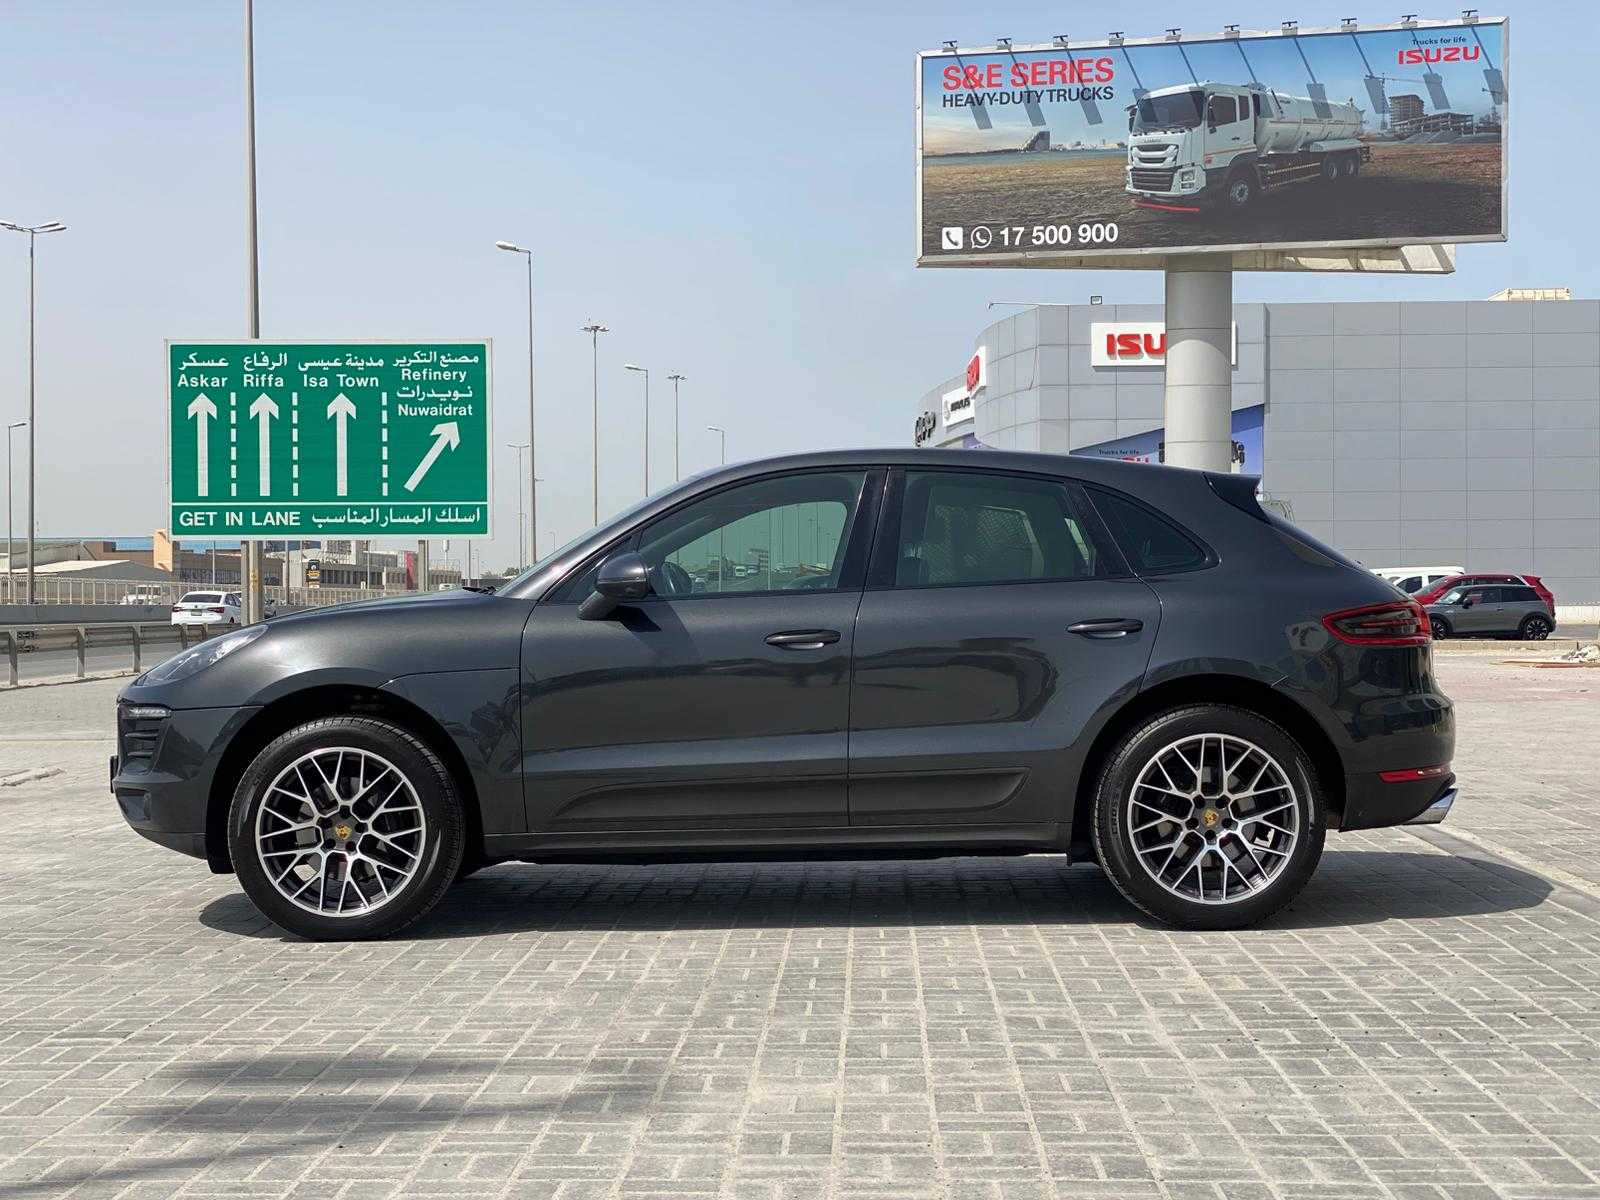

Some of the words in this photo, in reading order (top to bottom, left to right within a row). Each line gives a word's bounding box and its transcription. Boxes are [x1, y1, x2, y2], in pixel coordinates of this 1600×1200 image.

[1398, 46, 1479, 65] ISUZU
[943, 63, 1003, 90] S&E
[1010, 57, 1114, 88] SERIES
[942, 88, 1046, 108] HEAVY-DUTY
[1046, 85, 1114, 103] TRUCKS
[1000, 226, 1025, 246] 17
[1031, 225, 1072, 245] 500
[1078, 222, 1119, 243] 900
[1106, 333, 1167, 356] ISU
[178, 352, 229, 370] عسكر
[243, 351, 288, 372] الرفاع
[298, 355, 342, 371] عيسى
[346, 353, 384, 370] مدينة
[393, 350, 437, 367] التكرير
[439, 353, 480, 367] مصنع
[177, 373, 229, 388] Askar
[243, 373, 285, 388] Riffa
[303, 374, 328, 387] Isa
[336, 374, 379, 387] Town
[401, 368, 467, 382] Refinery
[396, 384, 473, 401] نويدرات
[398, 404, 473, 416] Nuwaidrat
[179, 511, 217, 526] GET
[225, 511, 243, 526] IN
[251, 511, 301, 526] LANE
[311, 507, 380, 528] المناسب
[380, 507, 431, 527] المسار
[435, 507, 481, 524] اسلك
